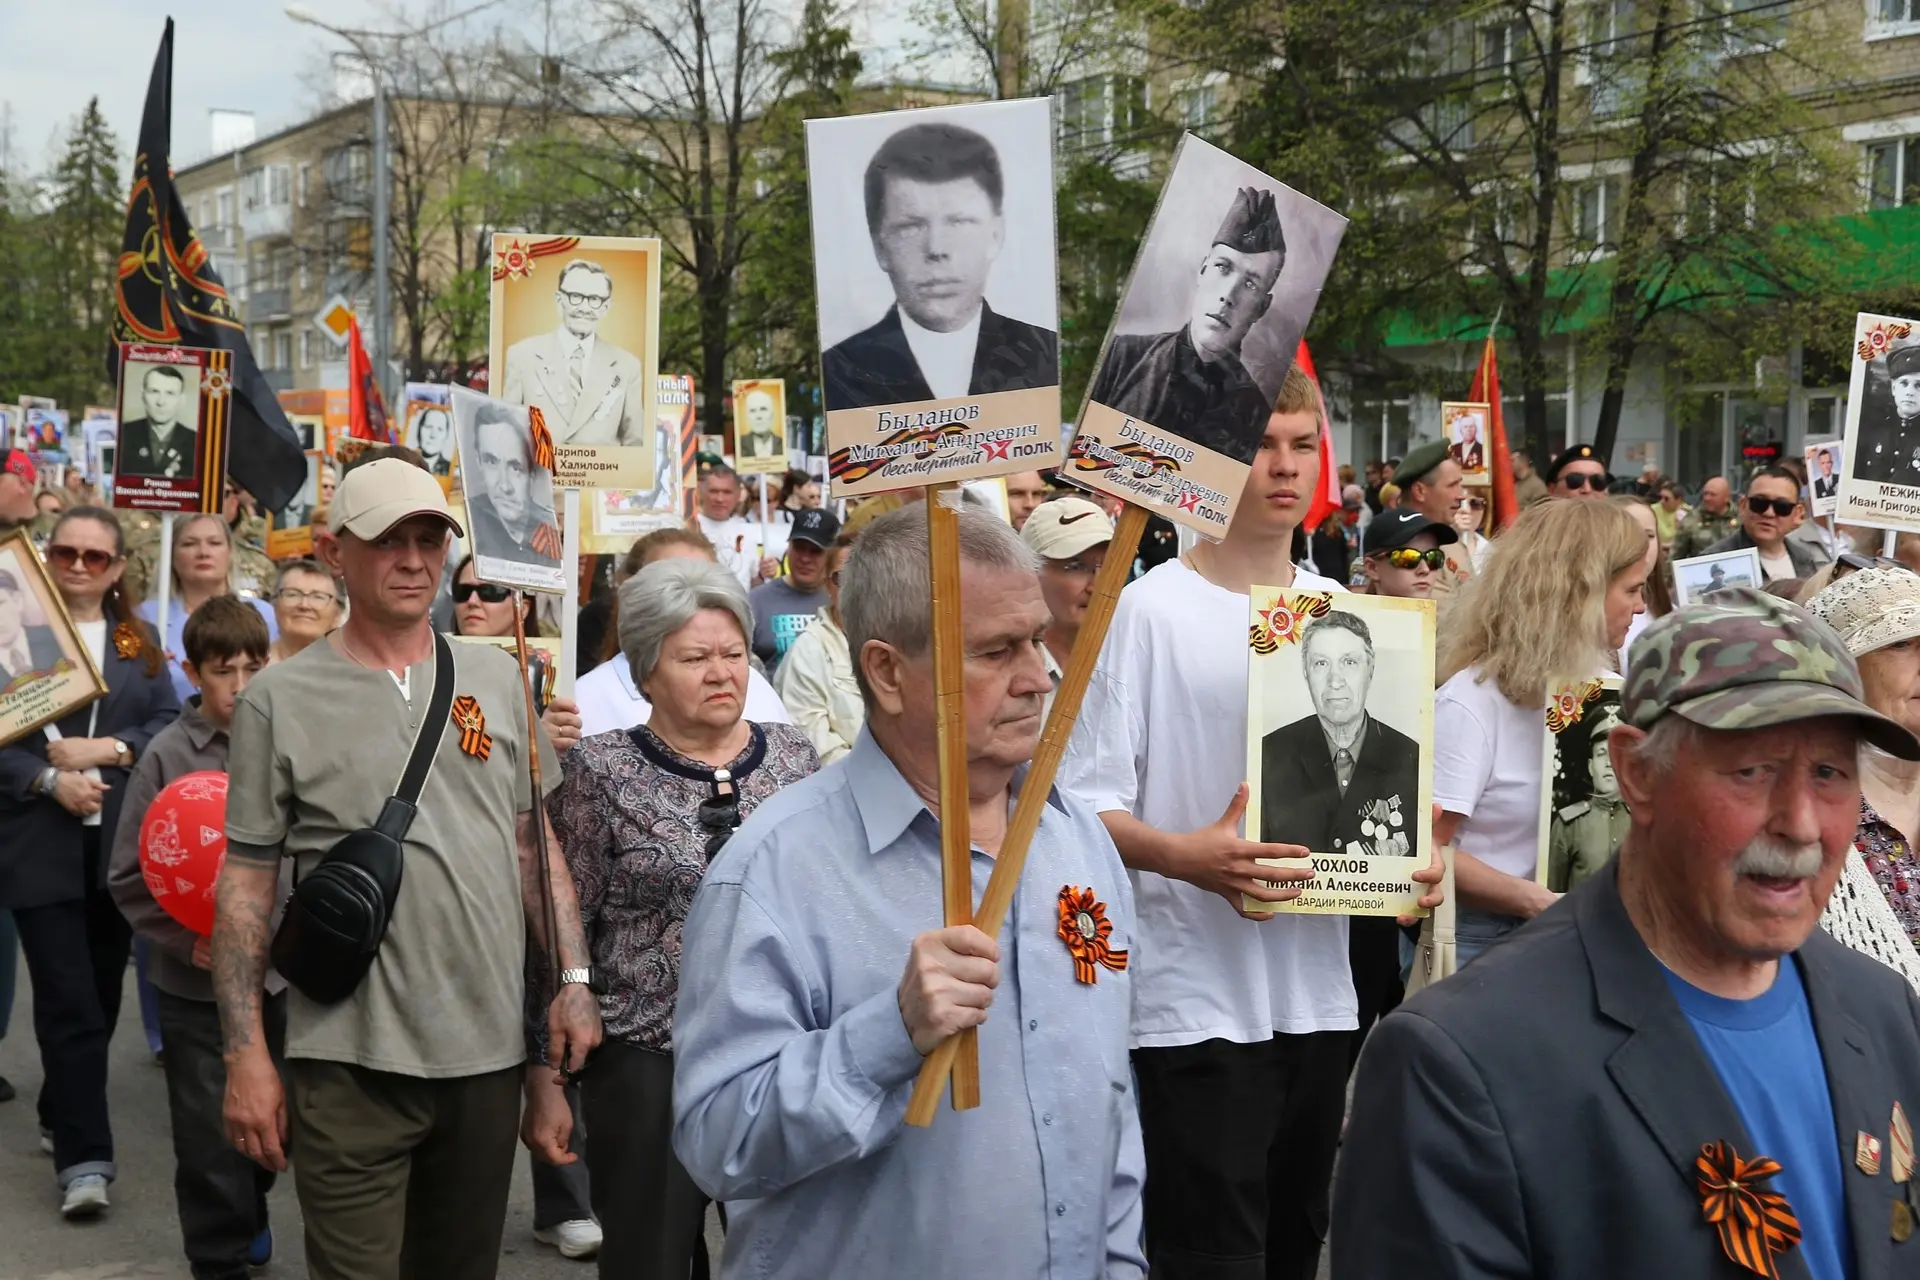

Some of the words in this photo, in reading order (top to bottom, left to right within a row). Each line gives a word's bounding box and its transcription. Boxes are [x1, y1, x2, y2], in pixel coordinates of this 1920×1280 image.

[876, 404, 980, 433] Быданов
[847, 440, 929, 464] Михаил
[934, 423, 1039, 451] Андреевич
[1117, 417, 1196, 463] Быданов
[559, 459, 619, 471] Халилович
[881, 450, 984, 478] бессмертный
[1013, 441, 1055, 458] полк
[1078, 435, 1155, 476] Григорий
[1153, 465, 1230, 508] Андреевич
[552, 479, 586, 487] 941-1945
[1848, 494, 1878, 508] Иван
[1196, 505, 1230, 526] полк
[1311, 858, 1369, 874] ХОХЛОВ
[1266, 879, 1322, 891] Михаил
[1326, 877, 1412, 894] Алексеевич
[1338, 897, 1384, 910] РЯДОВОЙ
